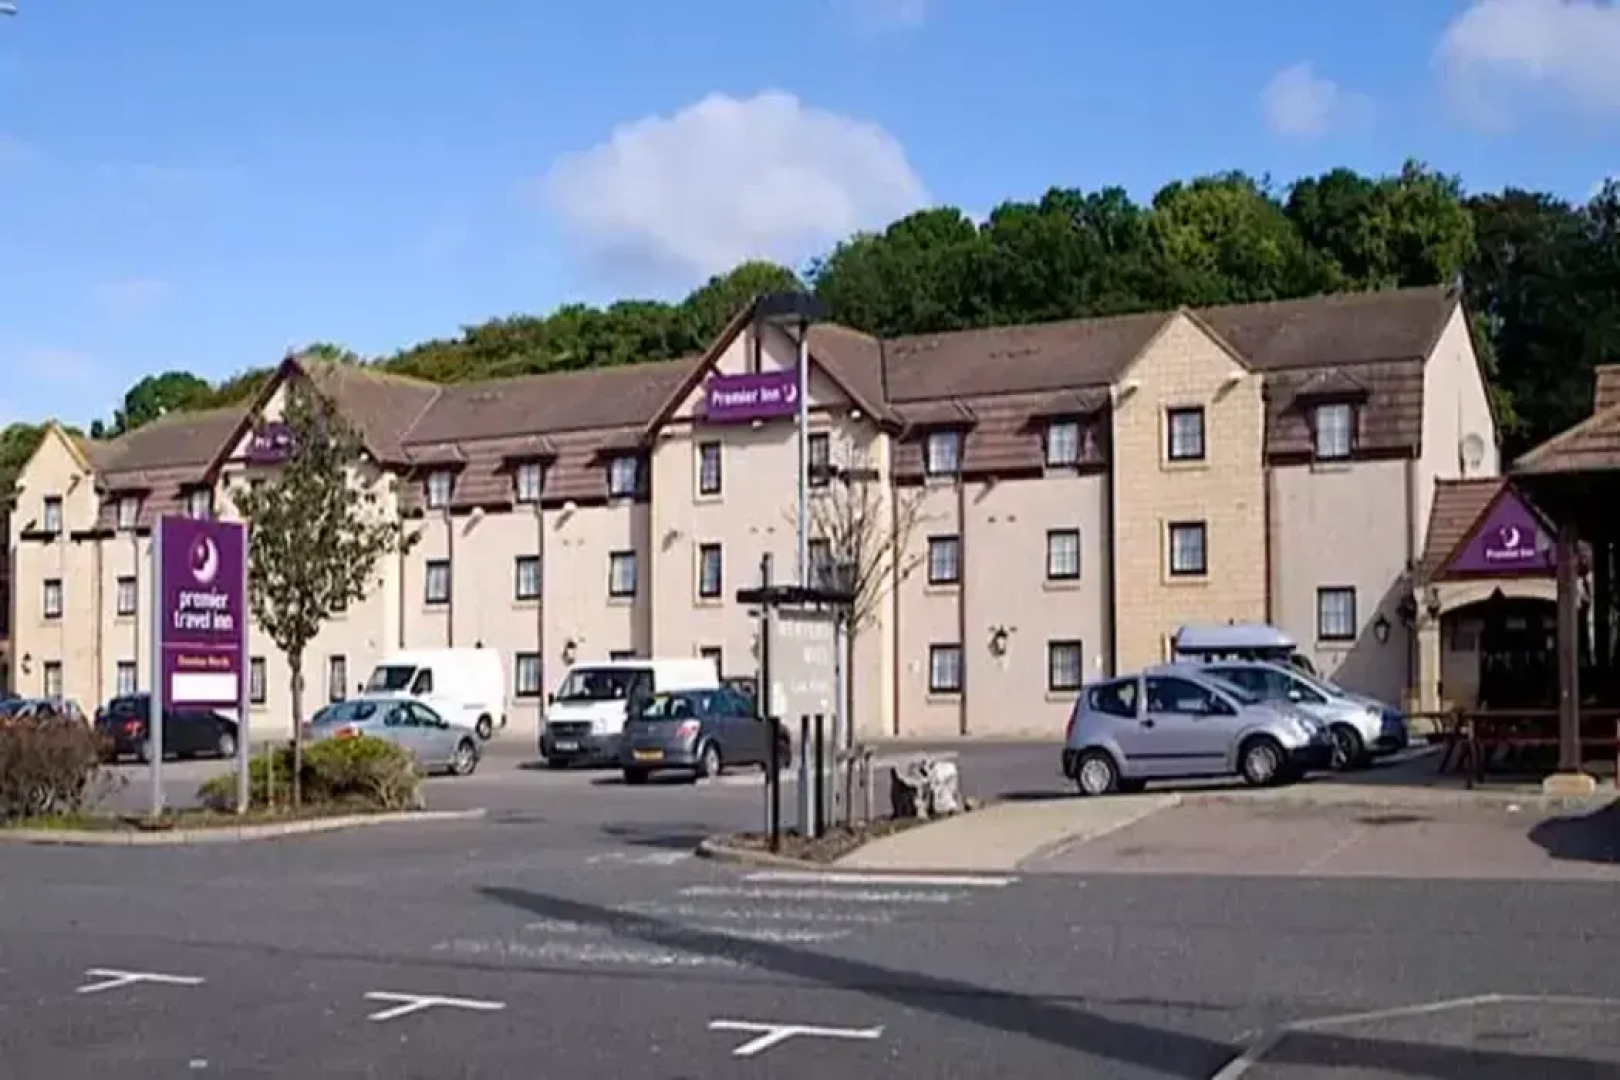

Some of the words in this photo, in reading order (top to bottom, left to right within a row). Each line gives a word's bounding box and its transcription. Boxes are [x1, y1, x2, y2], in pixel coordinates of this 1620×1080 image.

[712, 387, 758, 407] Premier
[760, 385, 780, 402] Inn
[179, 586, 228, 610] premier
[174, 610, 210, 629] travel
[213, 610, 234, 629] inn
